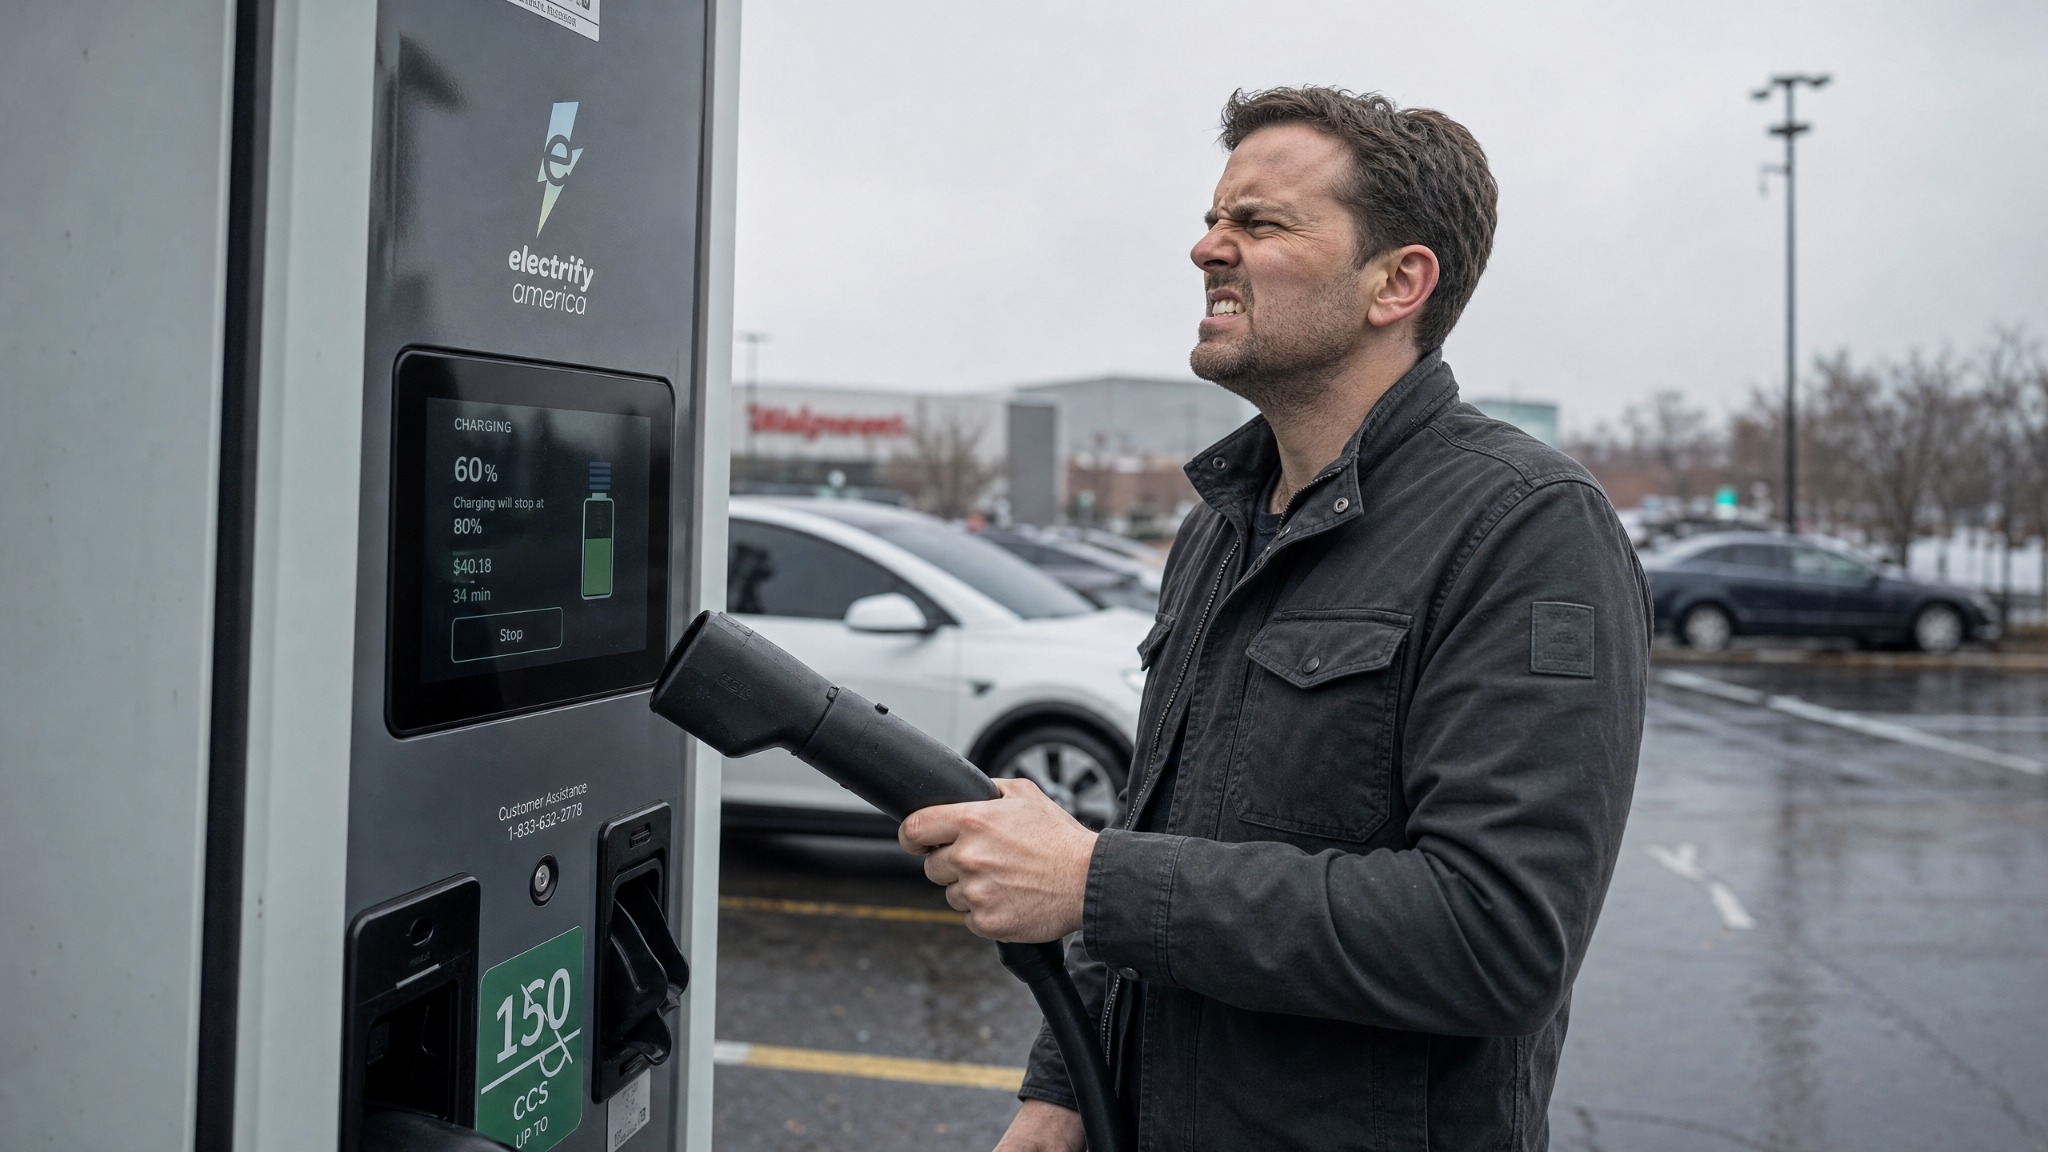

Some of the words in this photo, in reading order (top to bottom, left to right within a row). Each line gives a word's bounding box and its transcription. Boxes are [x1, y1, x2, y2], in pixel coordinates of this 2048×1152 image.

[508, 245, 594, 293] electrify
[512, 282, 587, 315] america
[454, 417, 512, 433] CHARGING
[454, 456, 498, 482] 60%
[453, 496, 496, 511] Charging
[497, 496, 513, 508] will
[514, 498, 534, 511] stop
[535, 498, 545, 508] at
[453, 518, 483, 535] 80%
[453, 558, 492, 576] $40.18
[452, 588, 467, 604] 34
[471, 587, 491, 602] min
[500, 628, 523, 643] Stop
[498, 796, 545, 822] Customer
[545, 783, 588, 807] Assistance
[508, 802, 583, 841] 1-833-632-2778
[496, 968, 571, 1064] 150
[513, 1080, 549, 1121] CCS
[516, 1128, 531, 1149] UP
[533, 1116, 549, 1138] TO
